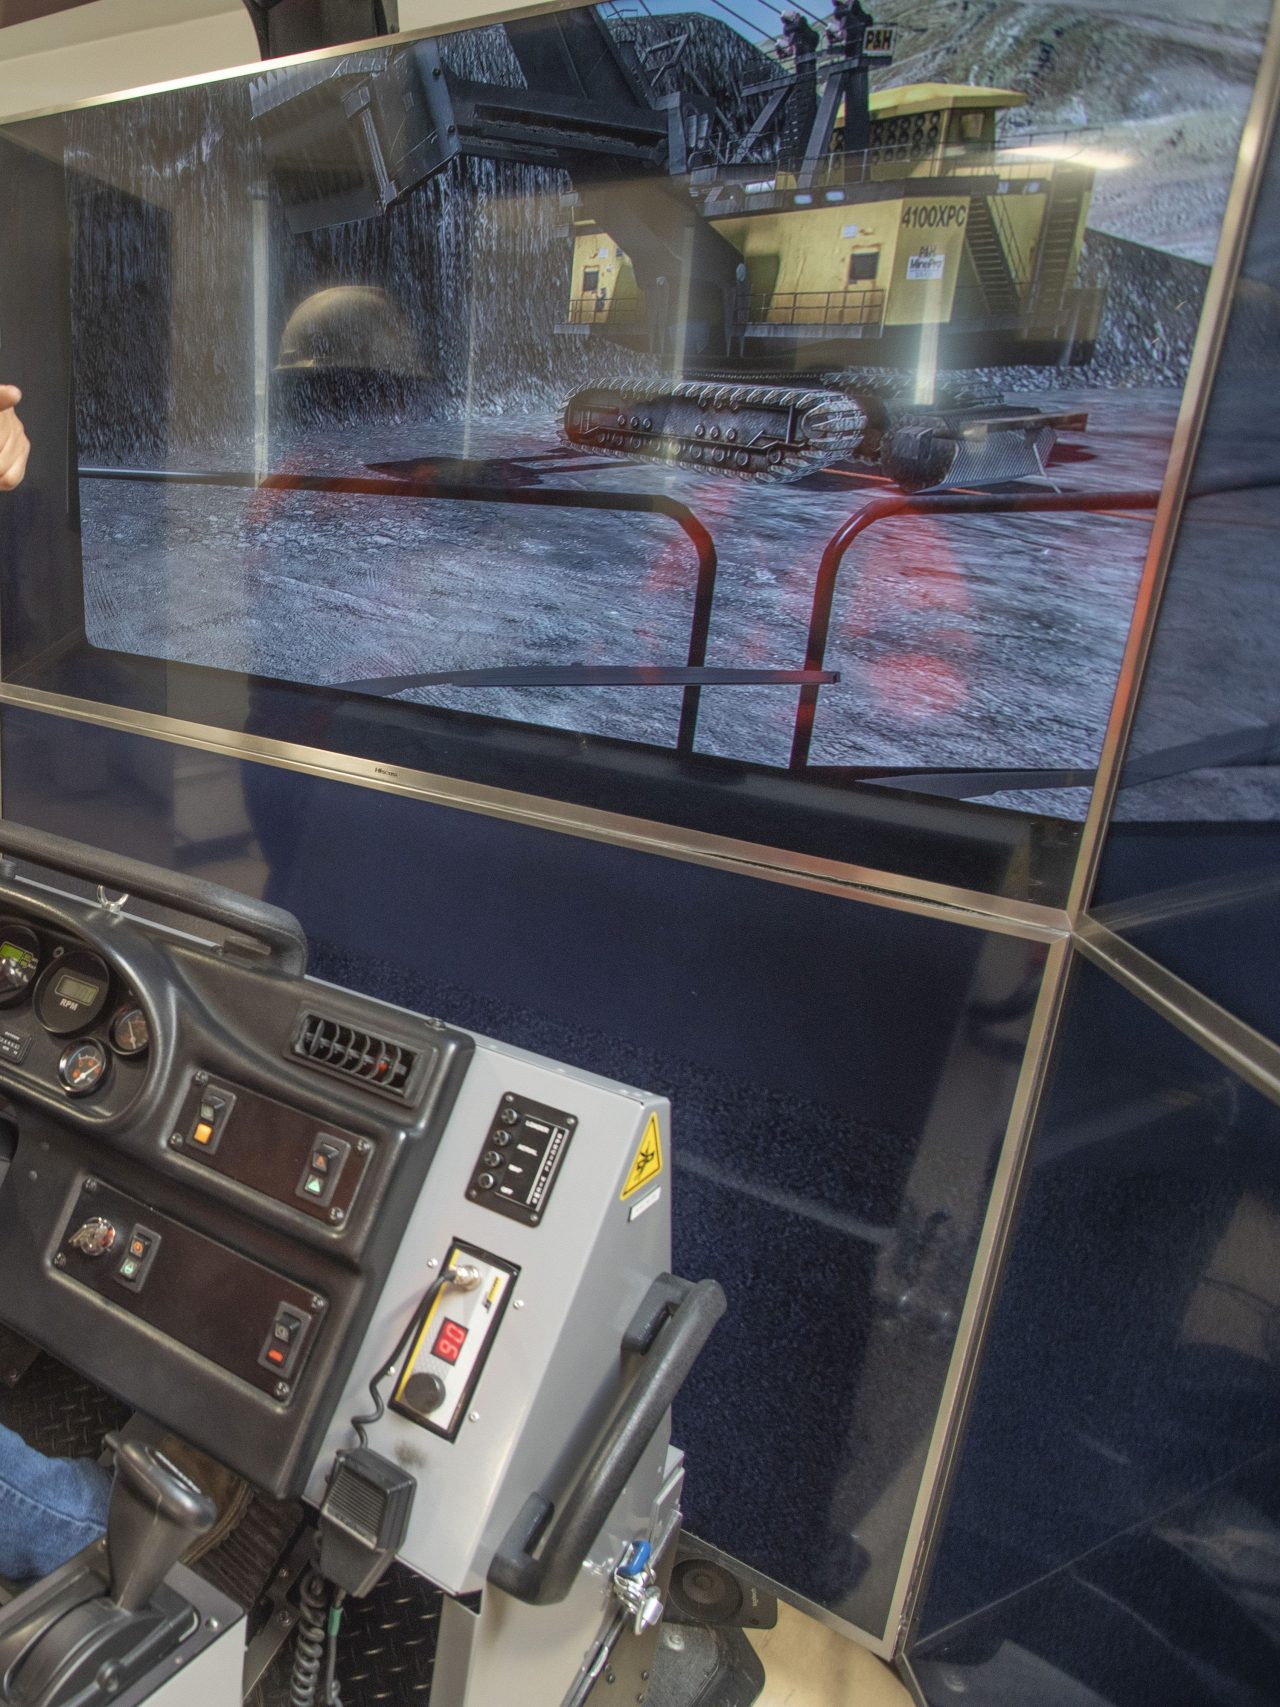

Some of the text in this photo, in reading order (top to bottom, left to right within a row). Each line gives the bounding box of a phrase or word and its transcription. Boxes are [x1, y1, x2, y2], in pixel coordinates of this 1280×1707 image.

[867, 29, 892, 50] P&H
[902, 205, 967, 228] 4100XPC
[60, 998, 78, 1011] RPM
[439, 1322, 465, 1360] 90
